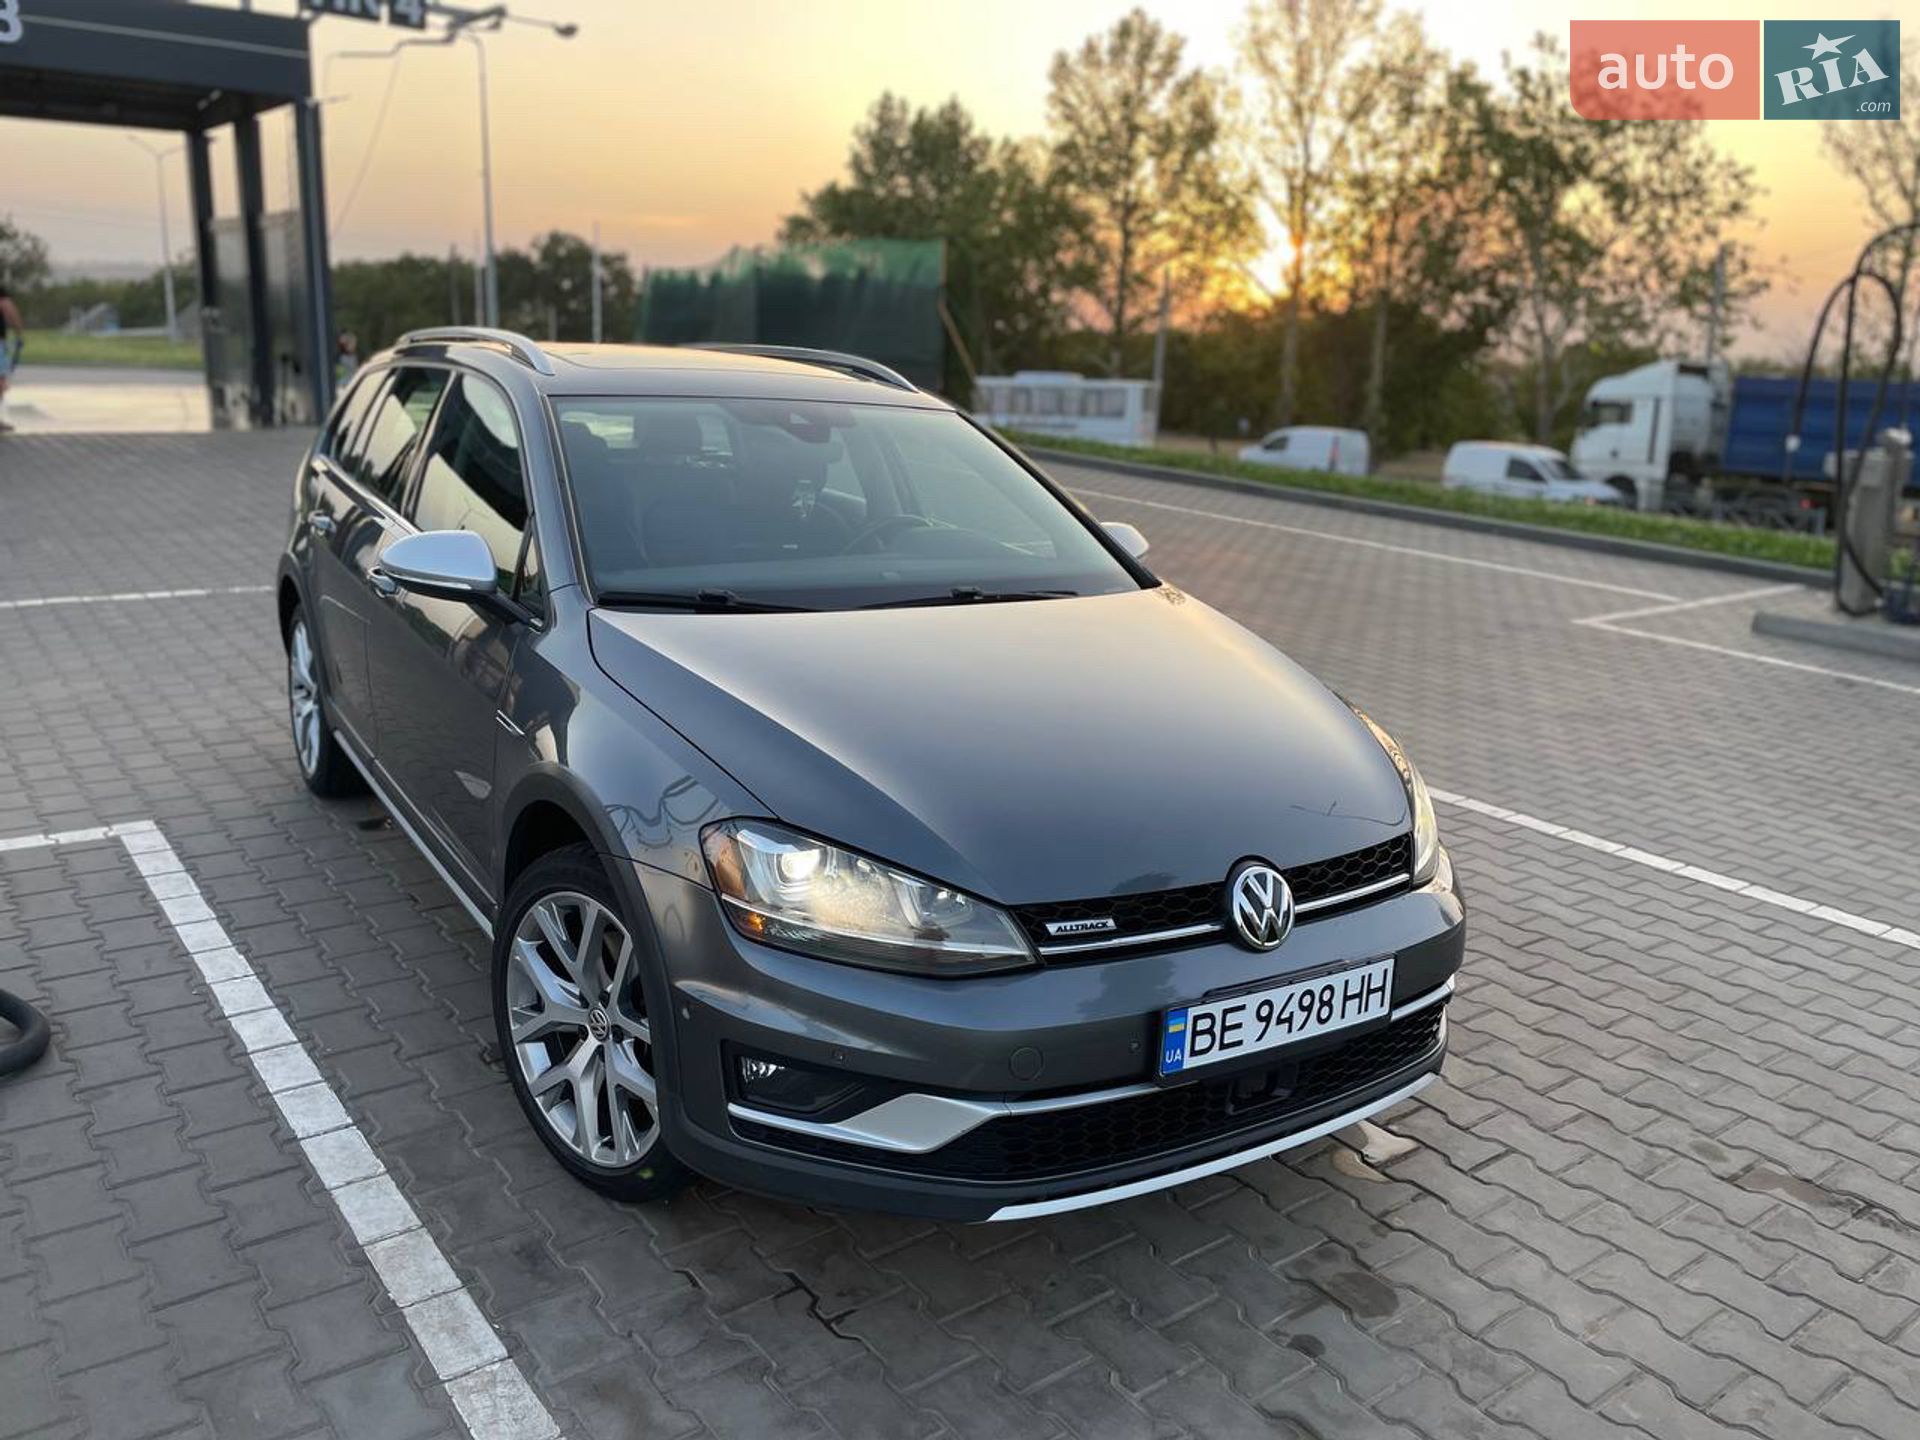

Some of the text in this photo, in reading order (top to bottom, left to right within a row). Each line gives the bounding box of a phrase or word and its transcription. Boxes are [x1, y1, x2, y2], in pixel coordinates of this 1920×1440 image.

[1055, 920, 1109, 933] ALLTRACK
[1189, 968, 1389, 1057] BE 9498 HH
[1165, 1048, 1182, 1063] UA
